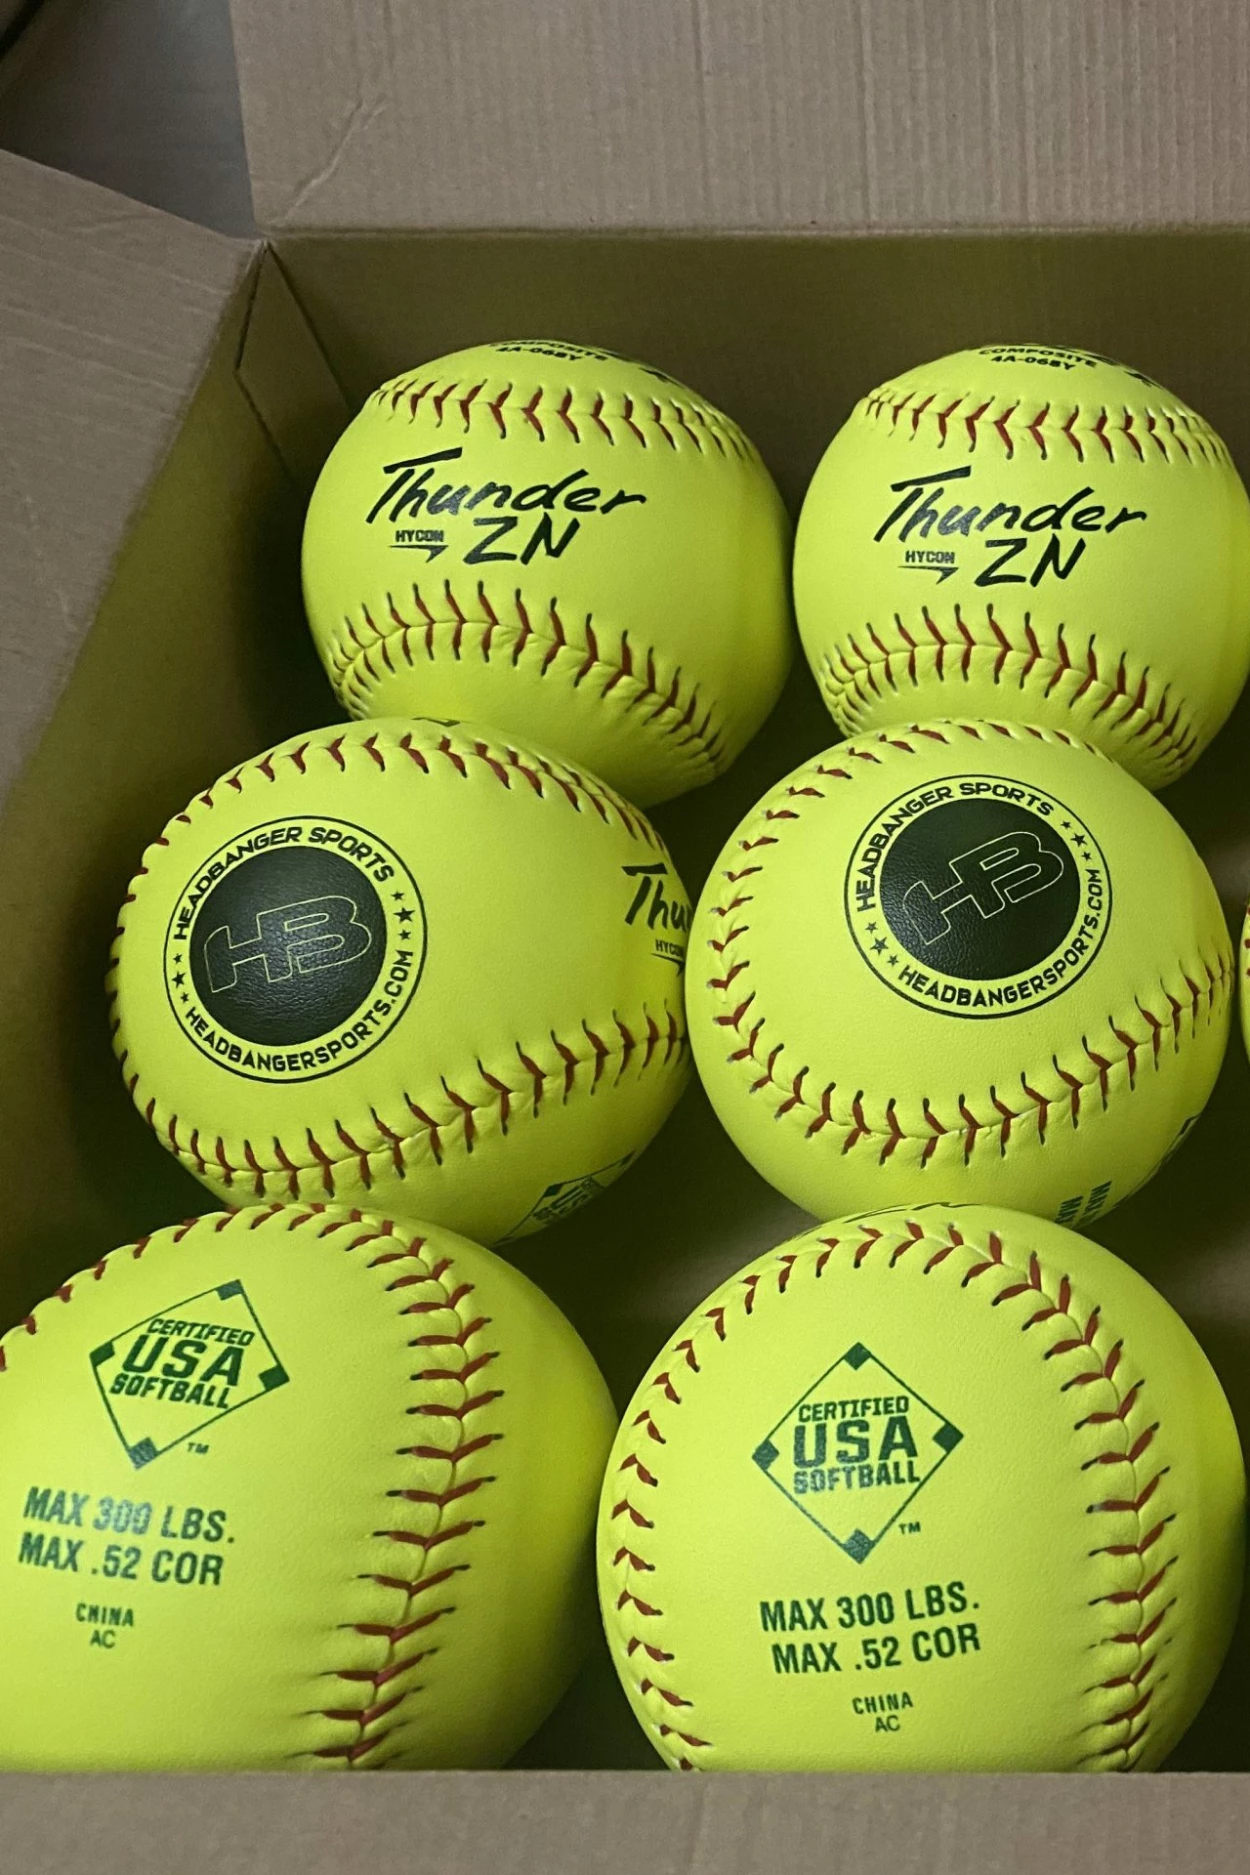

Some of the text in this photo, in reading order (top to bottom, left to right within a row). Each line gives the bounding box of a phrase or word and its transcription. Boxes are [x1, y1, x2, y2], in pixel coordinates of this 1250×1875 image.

[365, 447, 647, 523] Thunder
[874, 465, 1147, 543] Thunder
[395, 529, 444, 543] HYCON
[462, 511, 580, 565] ZN
[905, 550, 955, 565] HYCON
[974, 533, 1086, 588] ZN
[856, 782, 1054, 912] HEADBANGER SPORTS
[174, 826, 395, 940] HEADBANGER SPORTS
[898, 868, 1103, 1008] HEADBANGERSPORTS.COM
[185, 950, 414, 1072] HEADBANGERSPORTS.COM
[148, 1318, 255, 1347] CERTIFIED
[121, 1334, 245, 1387] USA
[110, 1373, 230, 1410] SOFTBALL
[798, 1395, 910, 1423] CERTIFIED
[793, 1416, 918, 1469] USA
[793, 1460, 921, 1495] SOFTBALL
[23, 1486, 235, 1544] MAX 300 LBS.
[18, 1531, 224, 1586] MAX .52 COR
[76, 1602, 135, 1627] CHINA
[759, 1581, 980, 1632] MAX 300 LBS.
[89, 1629, 116, 1649] AC
[771, 1622, 981, 1675] MAX .52 COR
[852, 1691, 913, 1715] CHINA
[874, 1715, 900, 1733] AC
